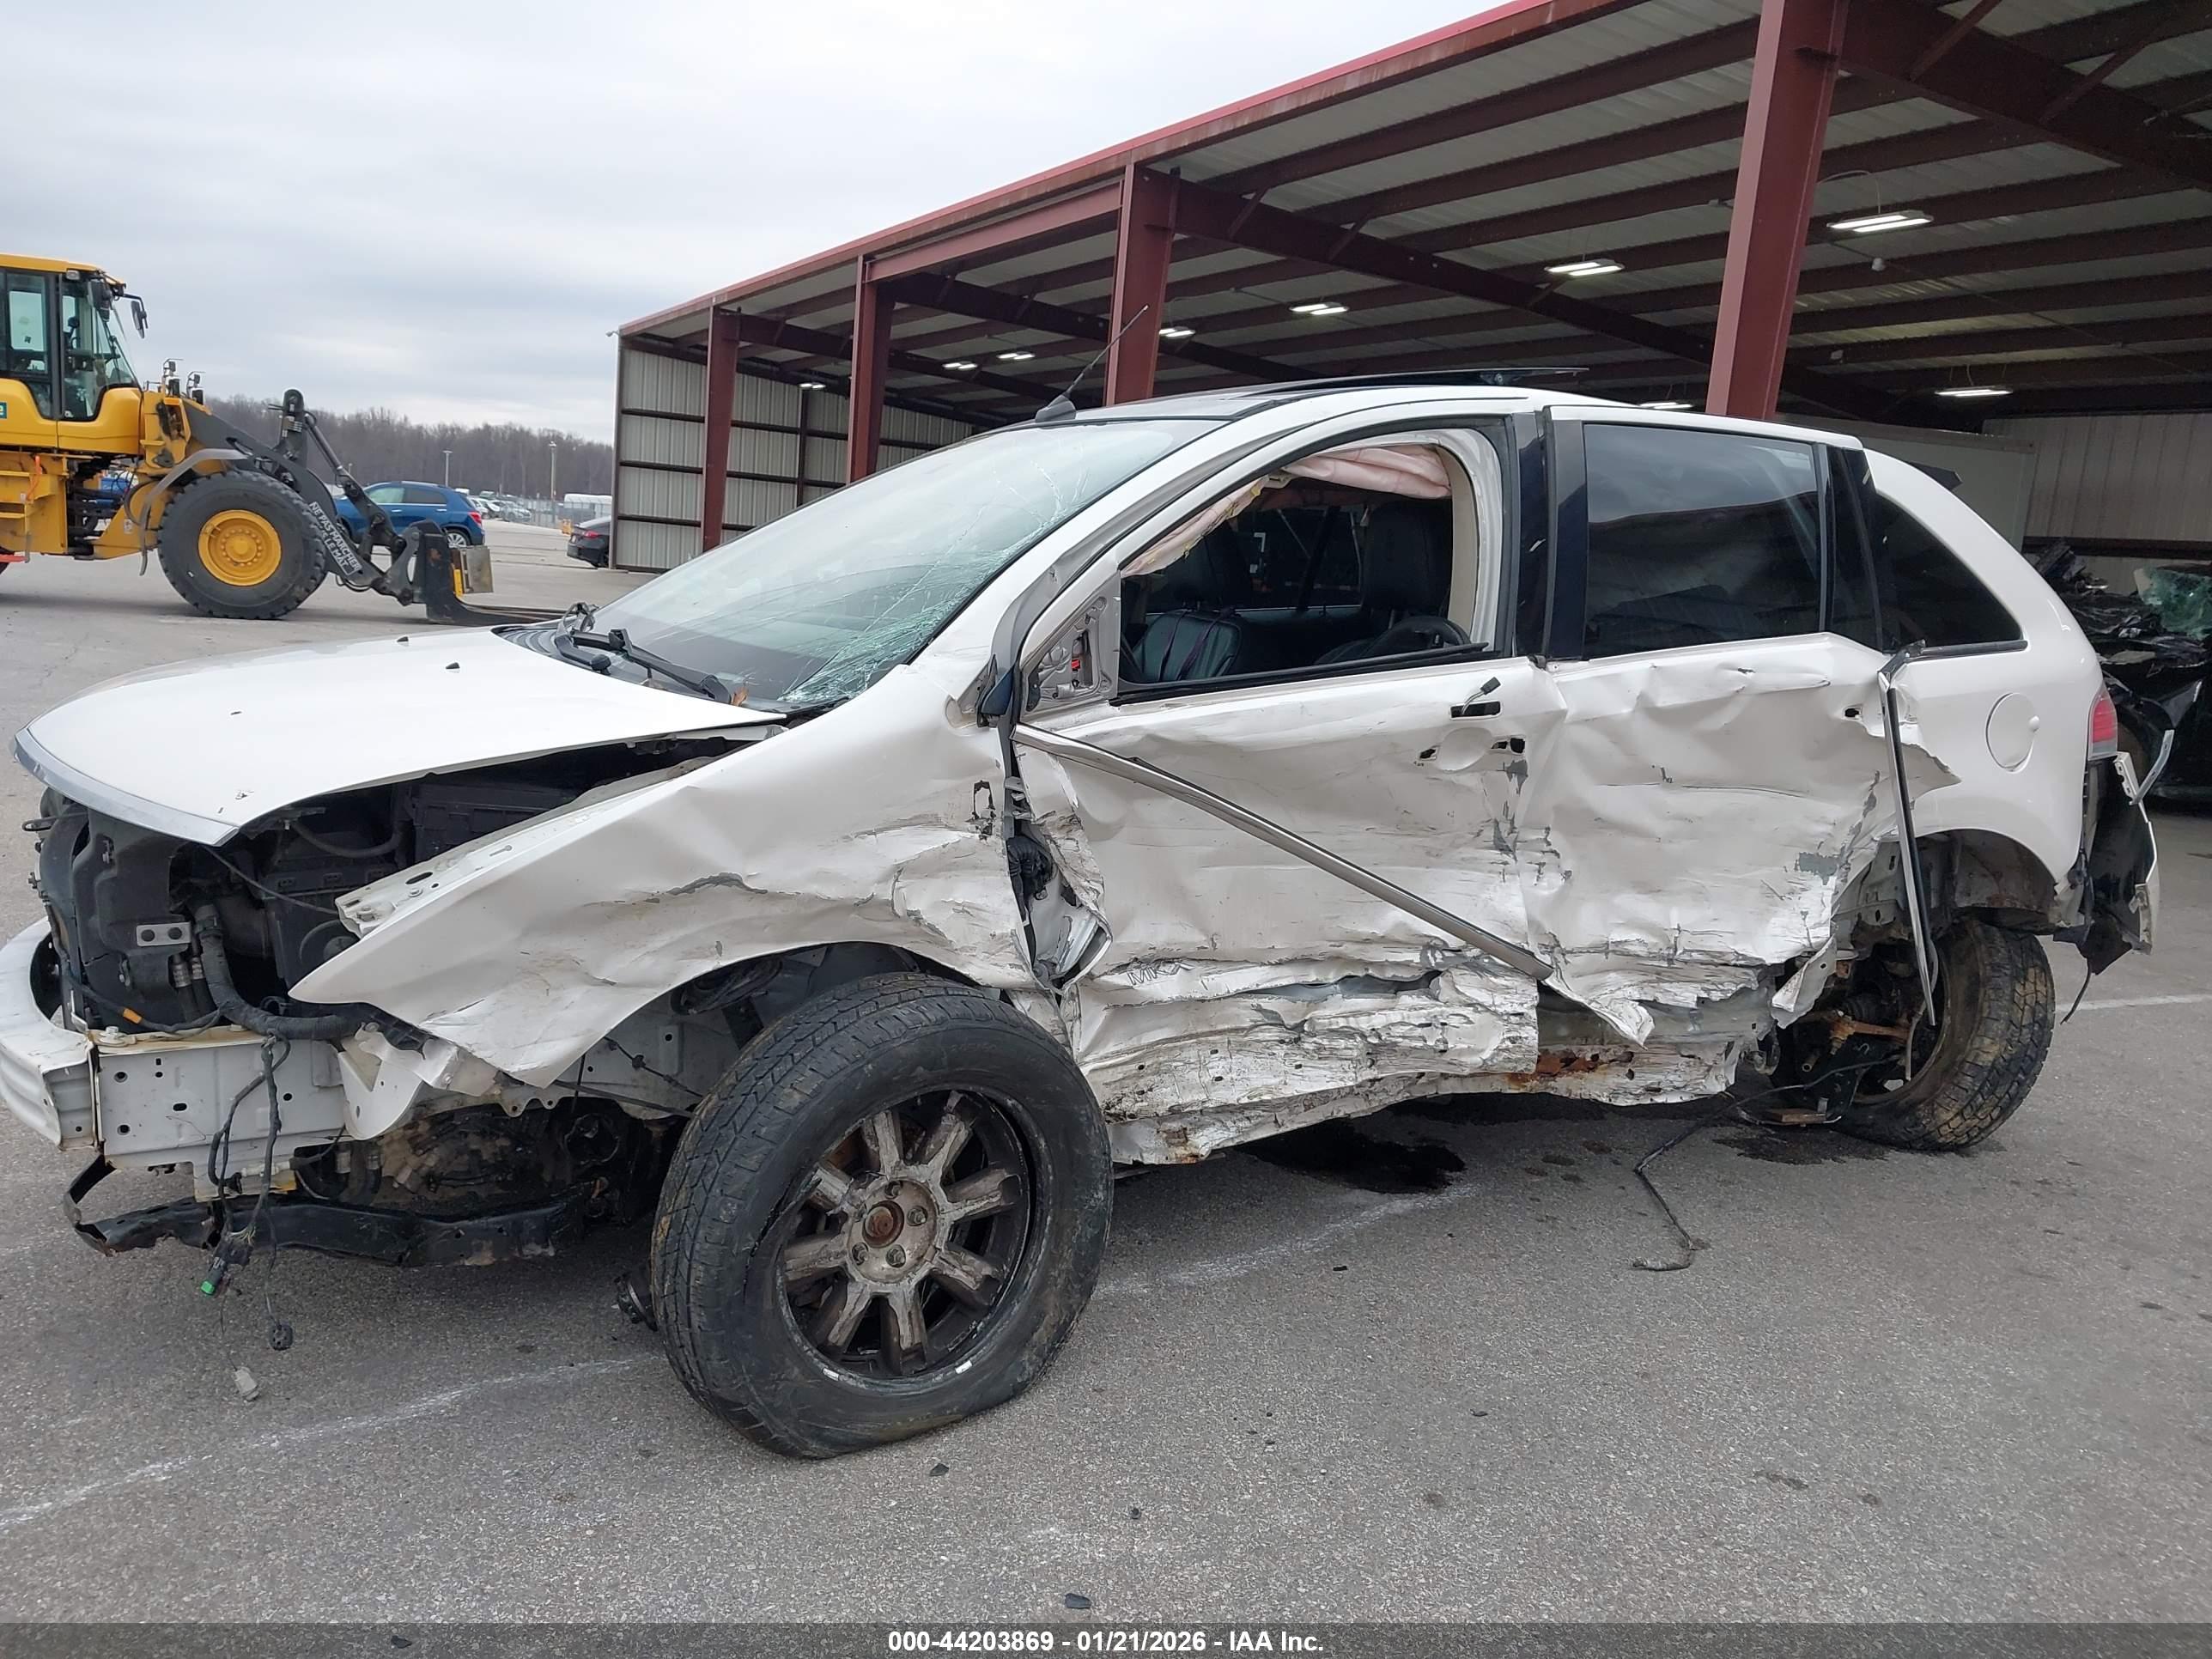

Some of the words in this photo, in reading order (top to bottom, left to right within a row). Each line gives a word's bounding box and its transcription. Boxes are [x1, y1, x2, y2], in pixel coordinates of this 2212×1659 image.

[309, 501, 321, 515] NE
[319, 514, 332, 531] PAS
[330, 531, 361, 570] MARCHER
[325, 538, 335, 548] LE
